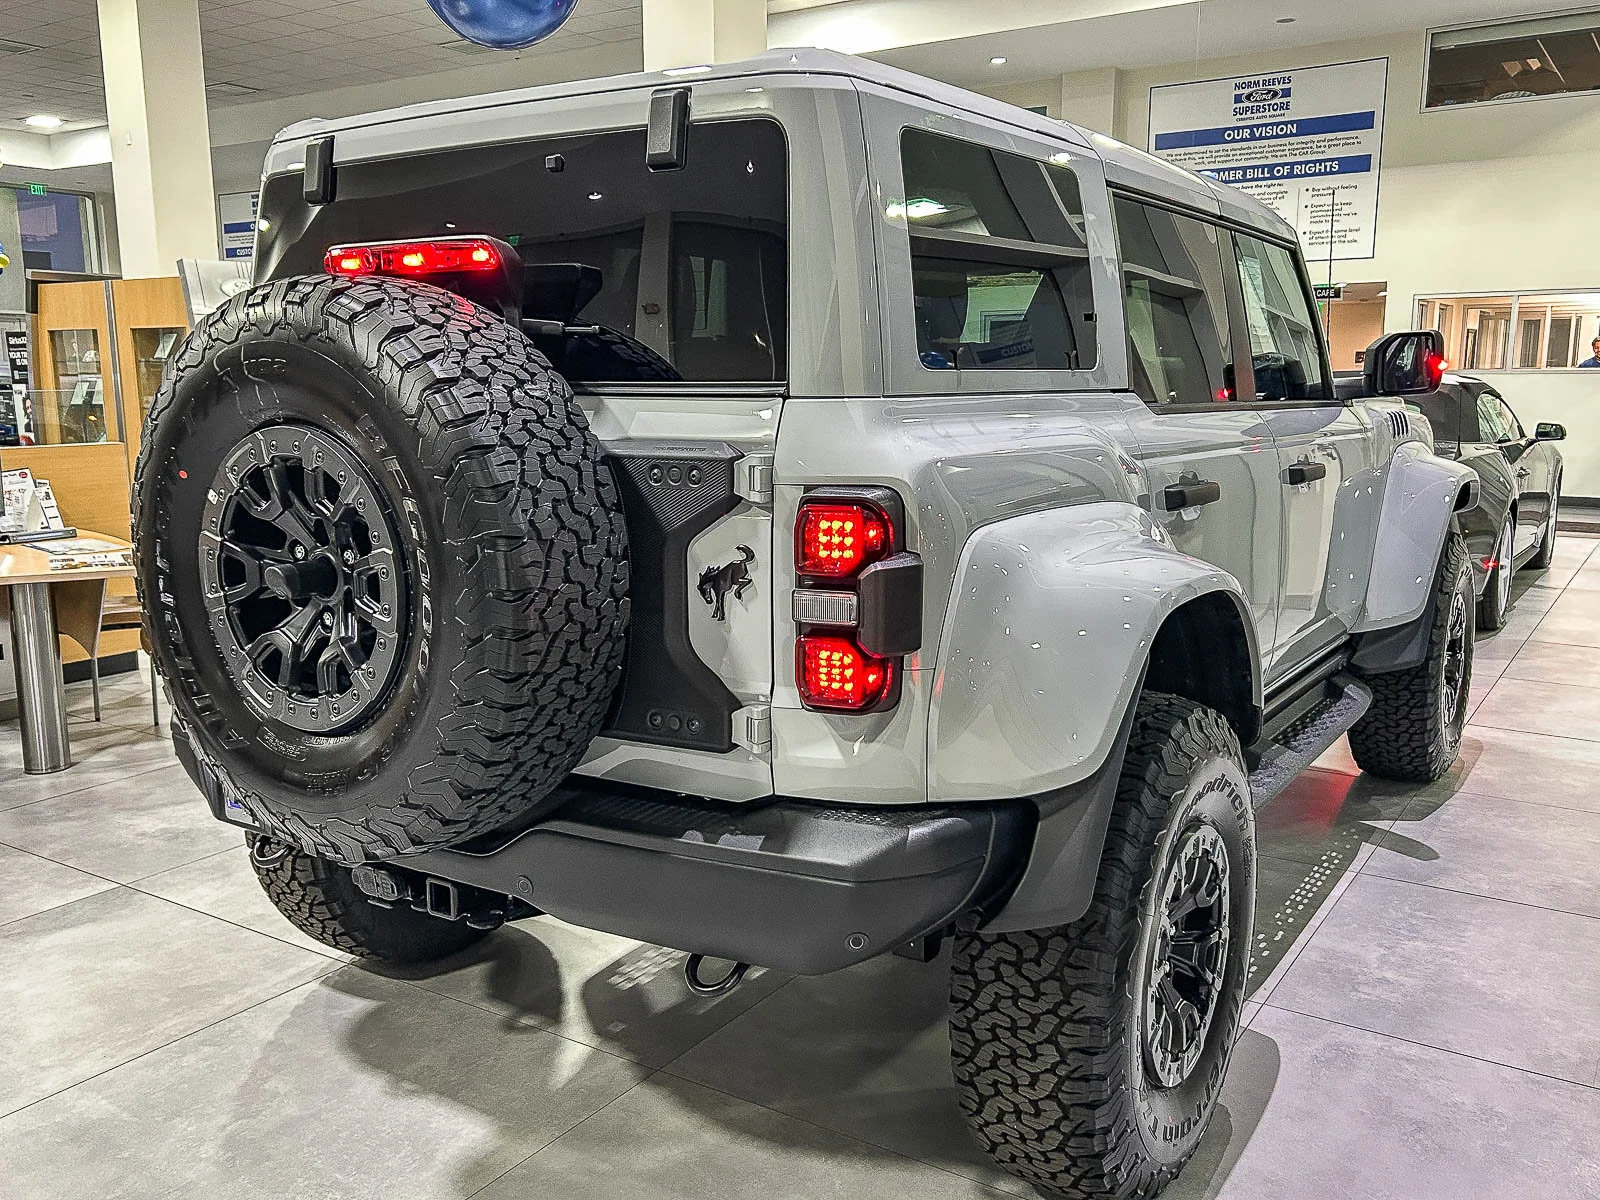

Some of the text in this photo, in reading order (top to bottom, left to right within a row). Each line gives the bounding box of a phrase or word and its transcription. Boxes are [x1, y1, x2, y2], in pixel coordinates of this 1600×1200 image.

[1234, 76, 1292, 90] NORM REEVES
[1232, 101, 1290, 116] SUPERSTORE
[1224, 124, 1297, 140] OUR VISION
[1246, 168, 1270, 178] BILL
[1274, 166, 1290, 176] OF
[1294, 161, 1339, 174] RIGHTS
[237, 248, 252, 256] CUSTO
